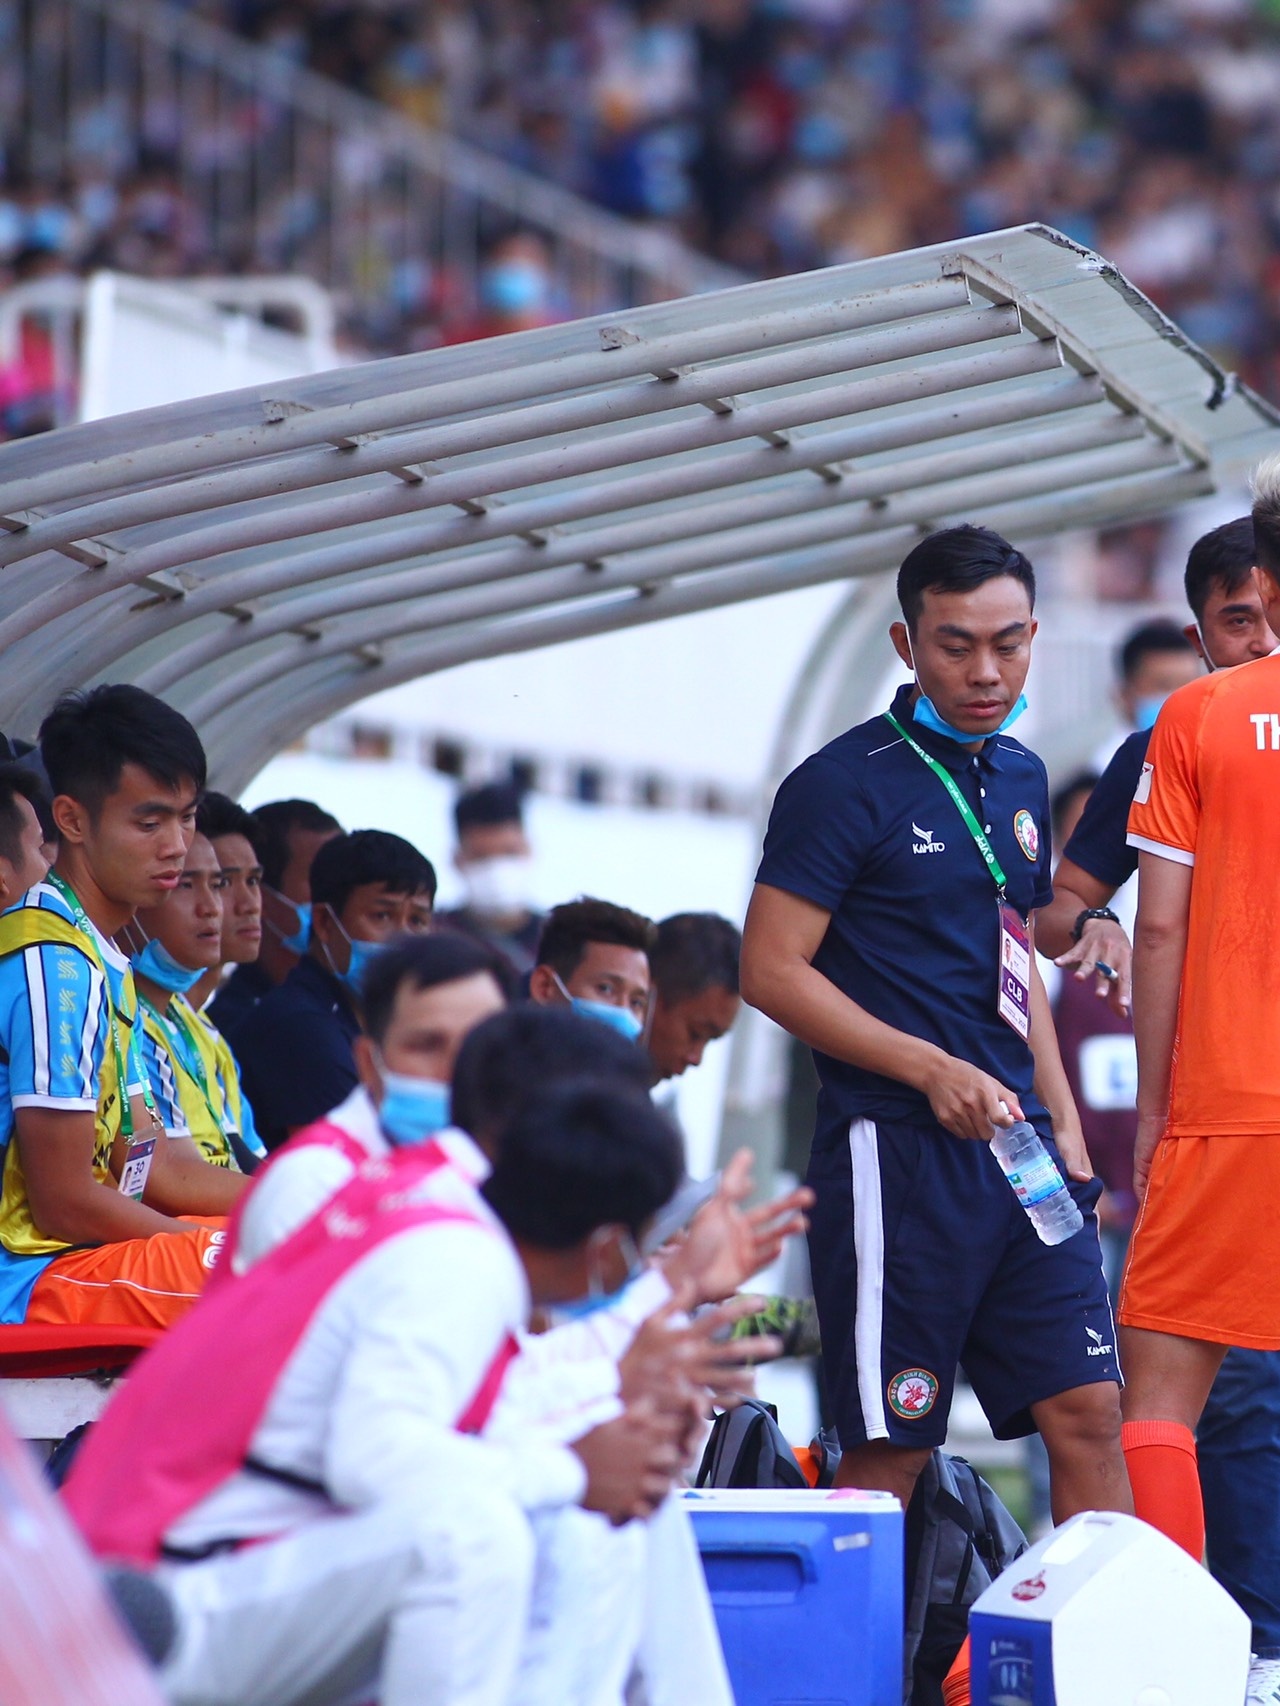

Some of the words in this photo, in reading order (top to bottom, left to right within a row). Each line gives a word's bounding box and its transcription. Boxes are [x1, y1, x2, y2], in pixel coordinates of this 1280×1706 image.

[912, 842, 945, 854] KAMITO
[974, 833, 991, 856] VPF
[1007, 977, 1023, 1003] CLB
[119, 1076, 129, 1113] www.vpf.vn
[134, 1160, 145, 1175] 30
